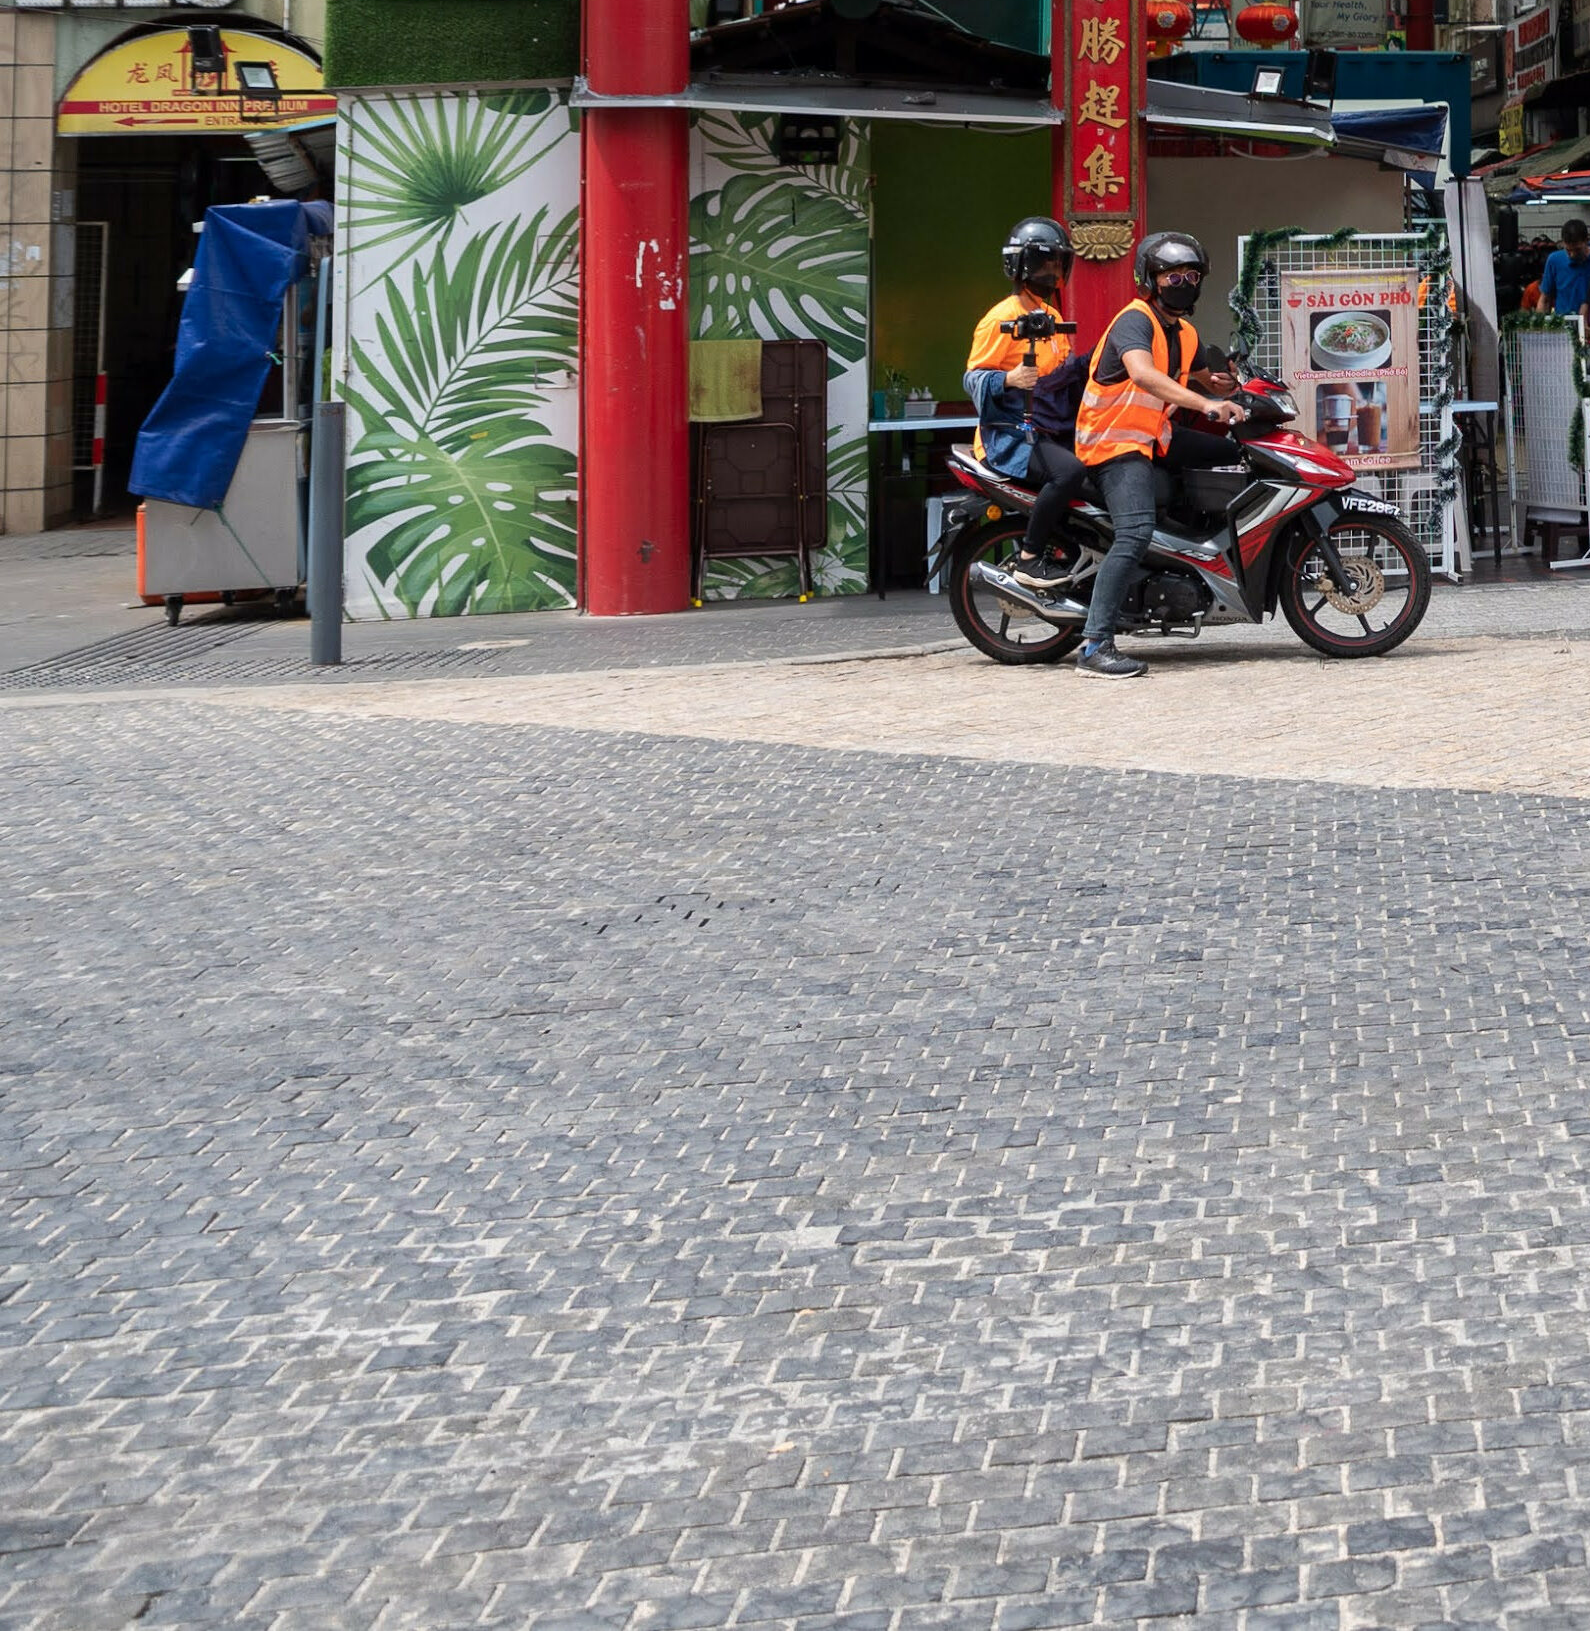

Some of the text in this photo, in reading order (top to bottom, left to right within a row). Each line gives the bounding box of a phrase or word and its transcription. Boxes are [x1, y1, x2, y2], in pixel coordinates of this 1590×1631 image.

[99, 102, 146, 114] HOTEL
[150, 101, 213, 113] DRAGON
[216, 101, 240, 112] INN
[1294, 371, 1325, 380] Vietnam
[1345, 369, 1377, 379] Noodles
[1360, 456, 1391, 465] Coffee
